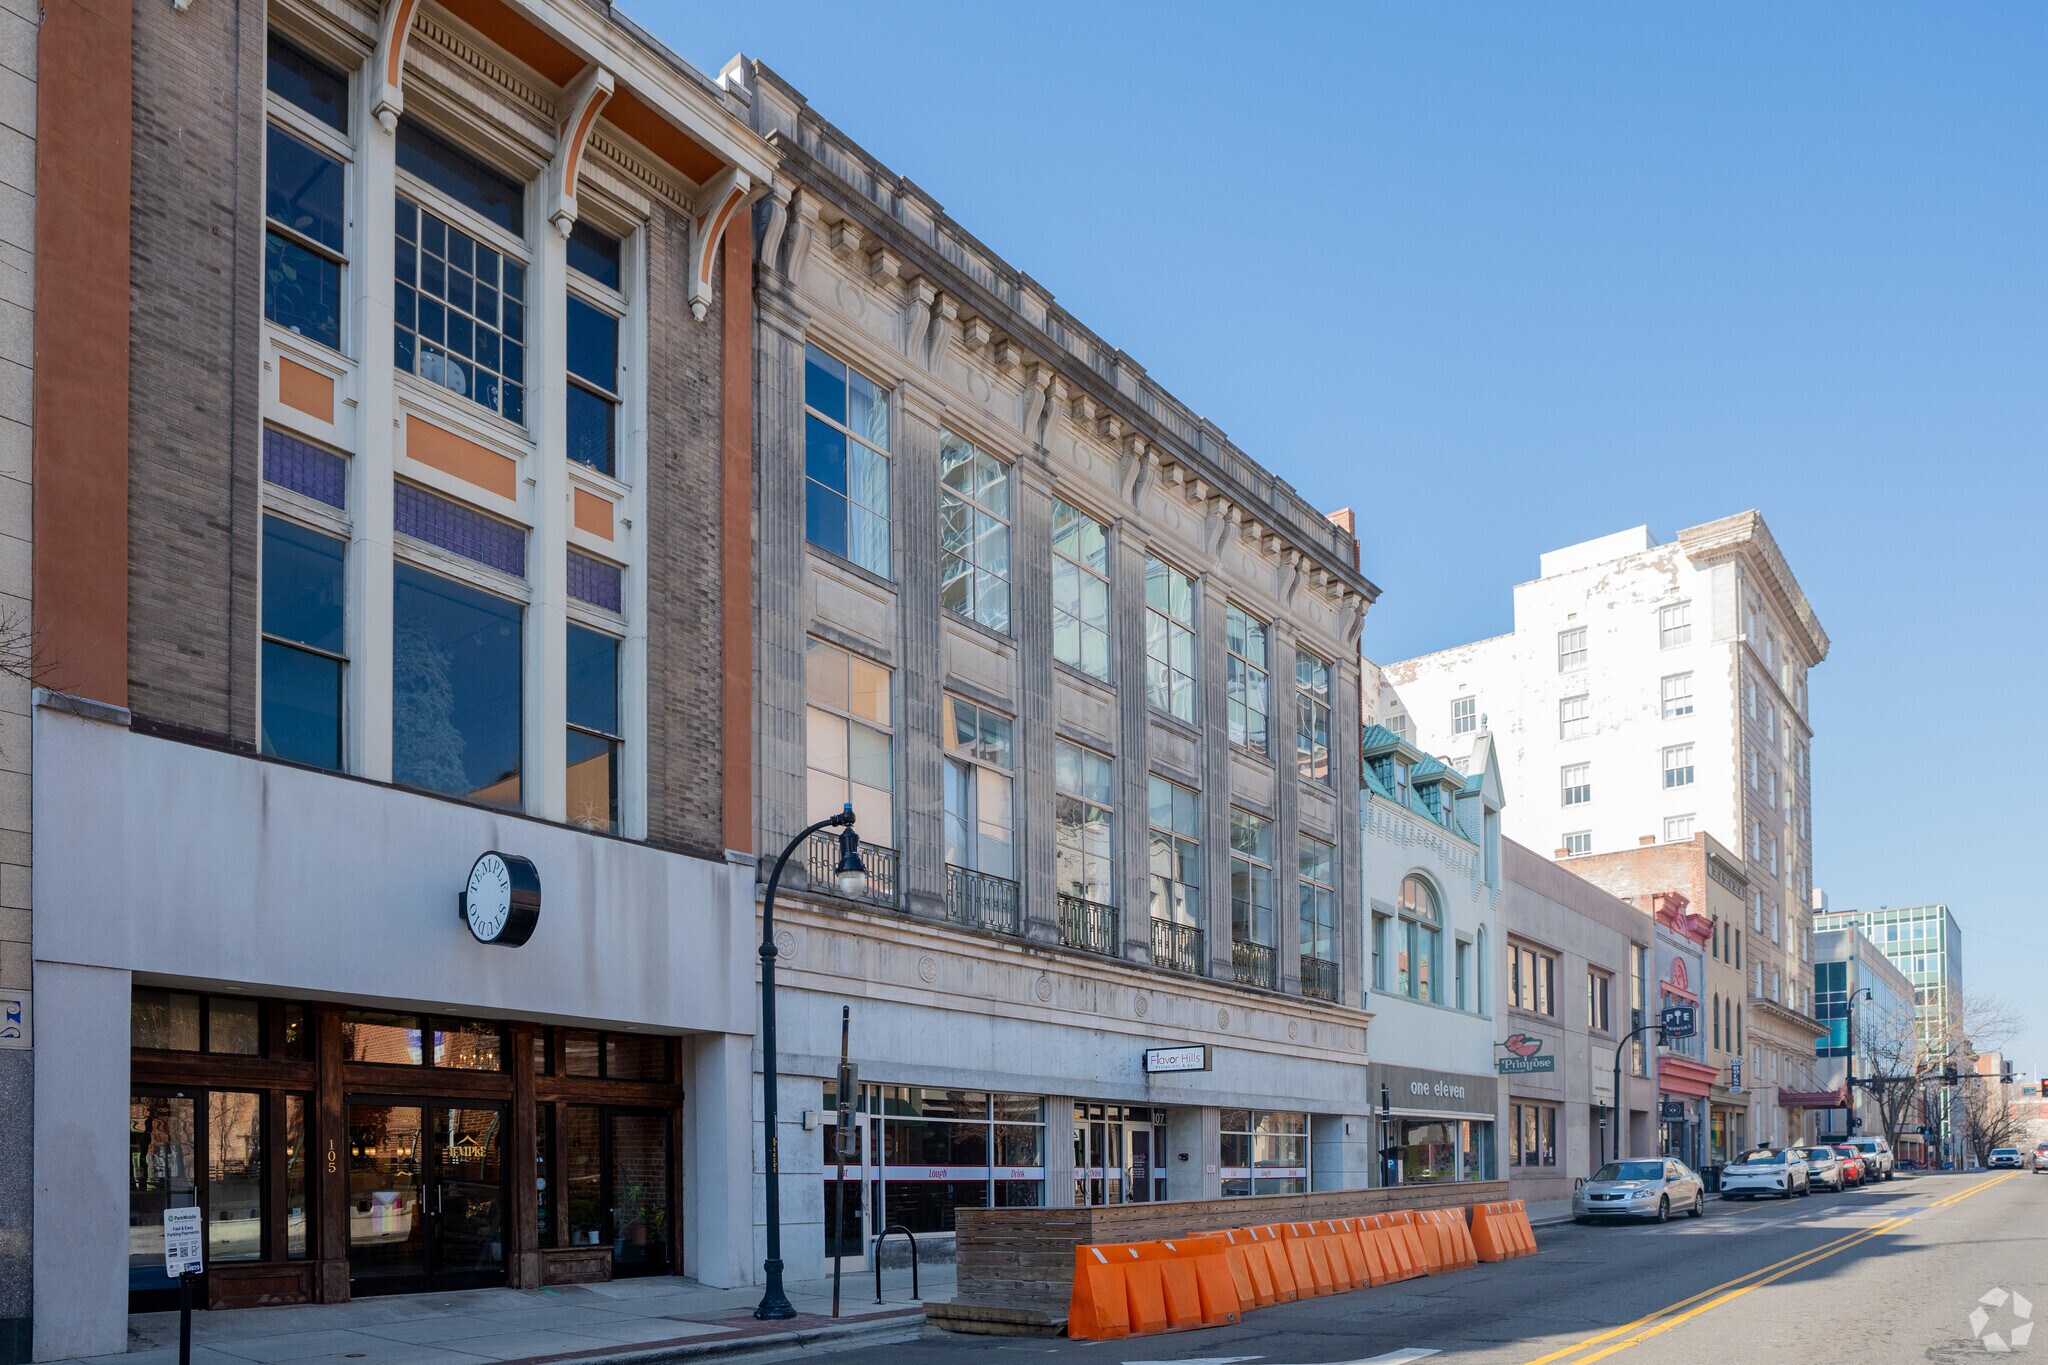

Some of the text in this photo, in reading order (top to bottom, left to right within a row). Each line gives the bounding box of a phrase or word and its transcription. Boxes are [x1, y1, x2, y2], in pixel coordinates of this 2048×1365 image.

[470, 858, 508, 893] TEMPLE
[470, 903, 506, 936] STUDIO
[1151, 1053, 1200, 1065] Flavor Hills
[1501, 1058, 1551, 1071] Primrose
[1410, 1080, 1465, 1099] one eleven
[1153, 1112, 1165, 1124] 07
[328, 1139, 336, 1173] 105
[929, 1169, 948, 1179] Laugh
[1011, 1169, 1025, 1178] Drink
